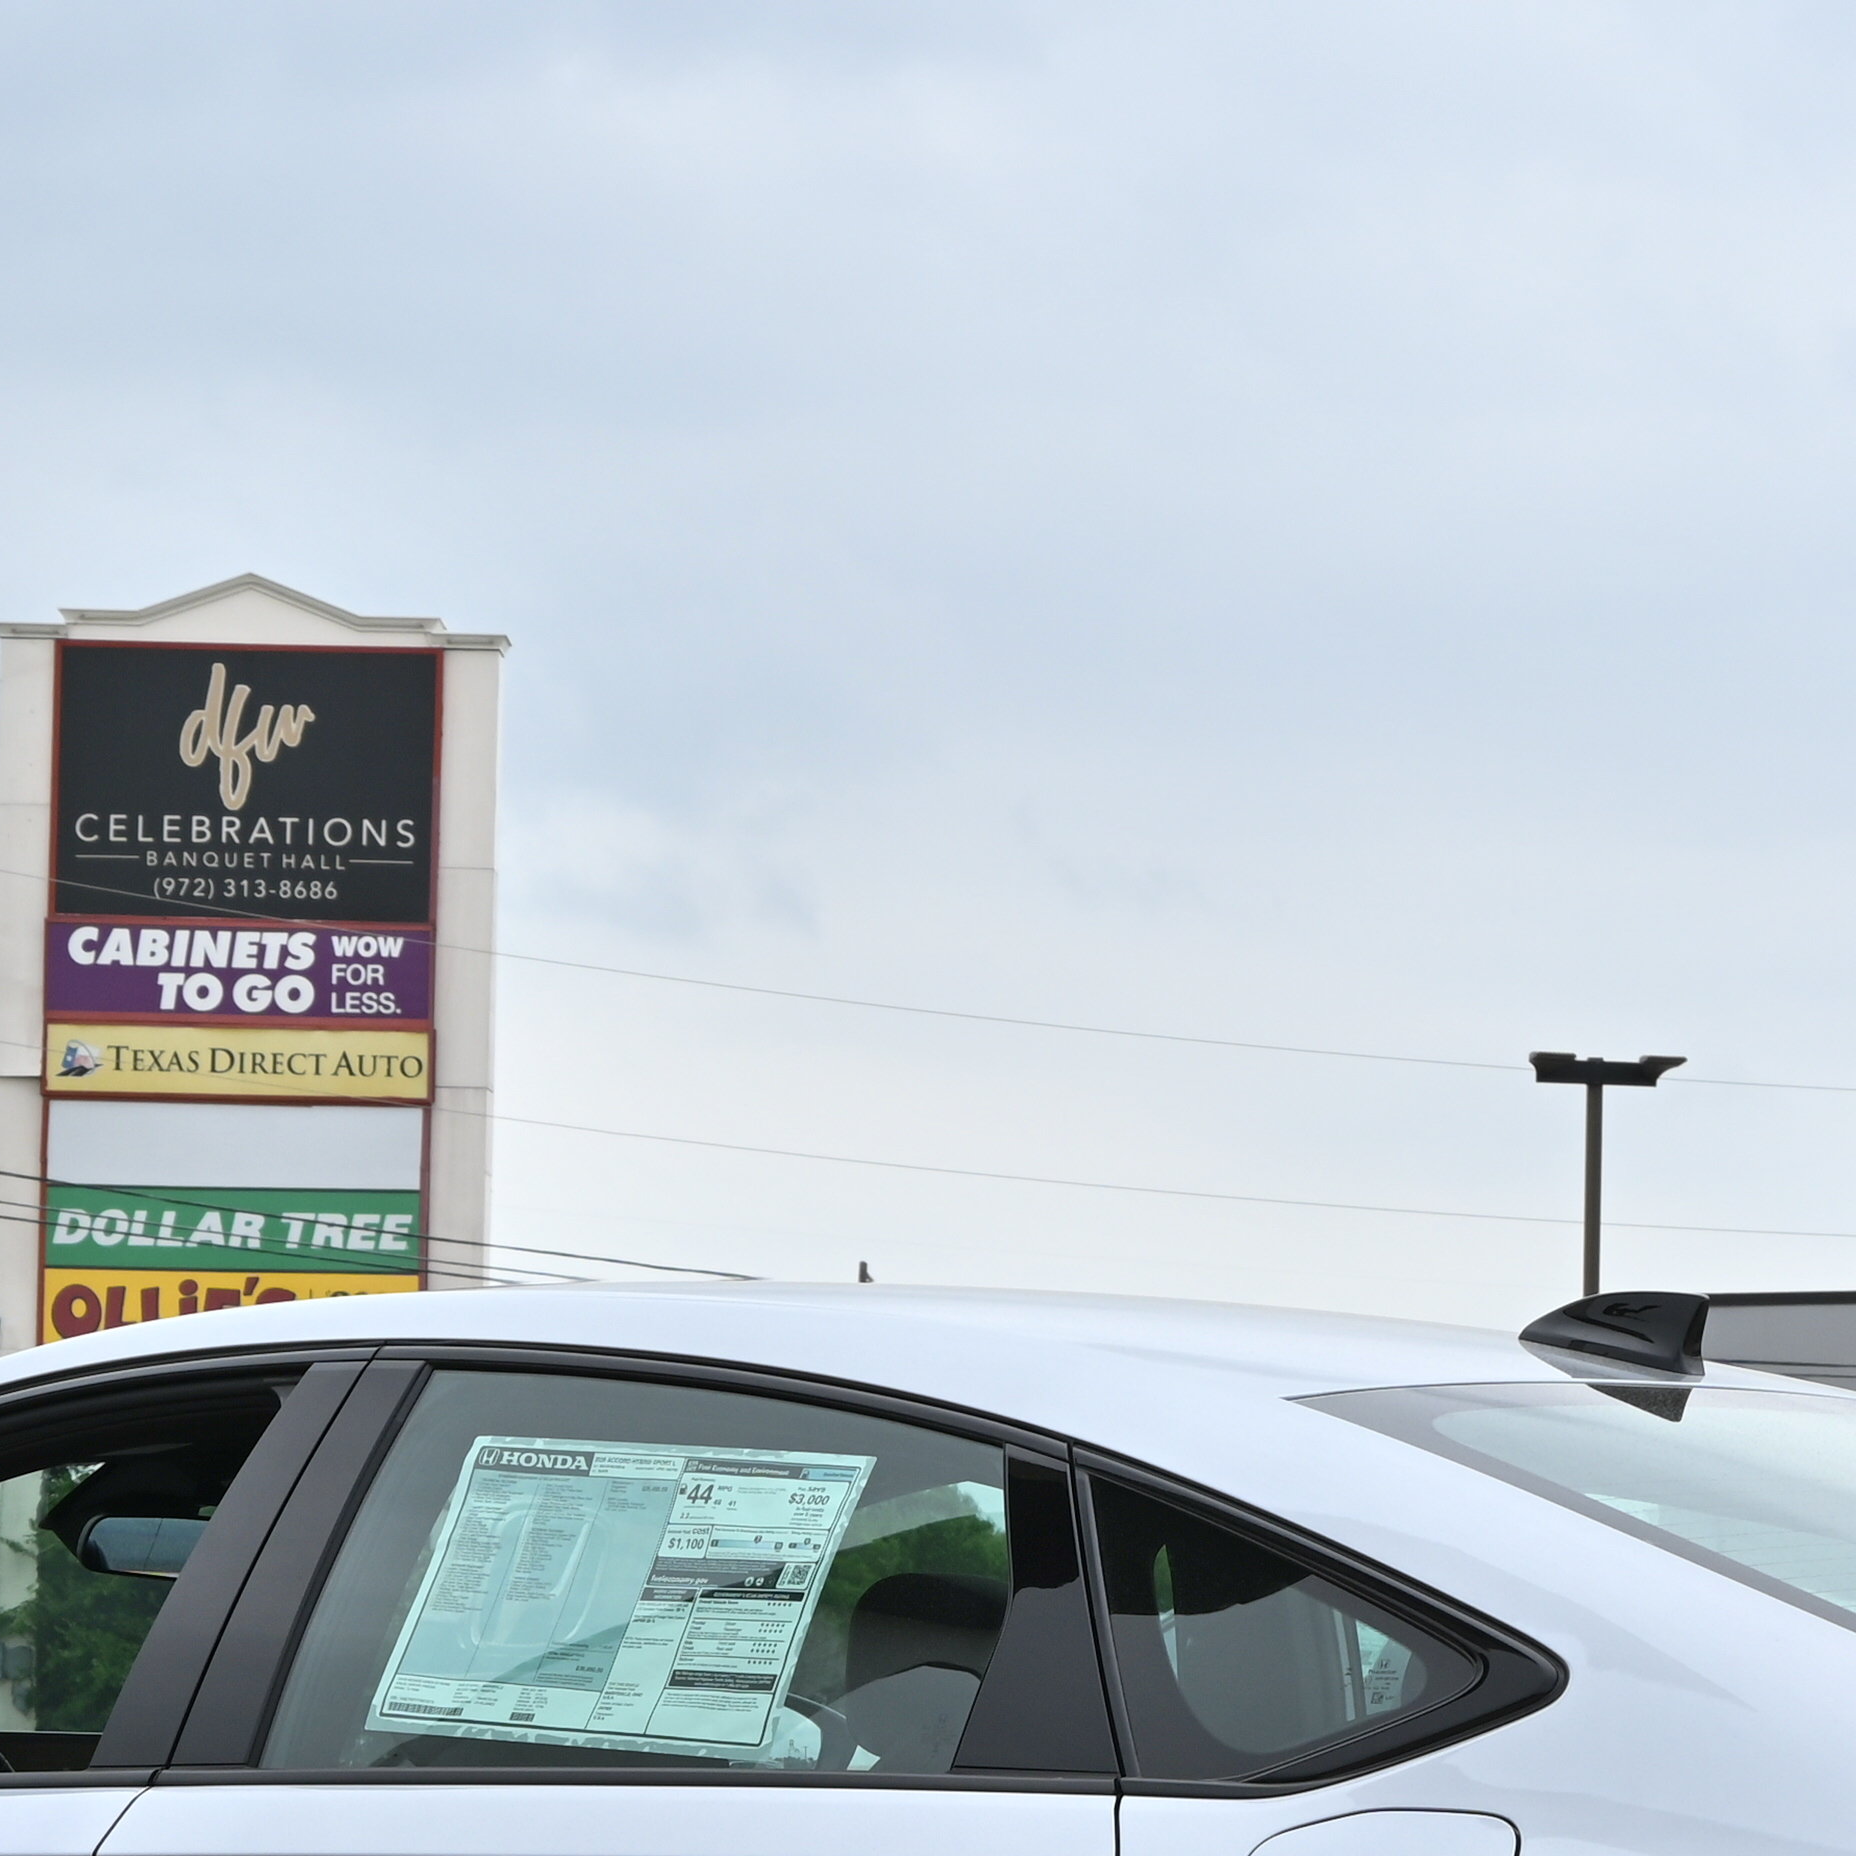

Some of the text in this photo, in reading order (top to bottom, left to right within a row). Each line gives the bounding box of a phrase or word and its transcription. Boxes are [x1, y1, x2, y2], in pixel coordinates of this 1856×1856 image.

[179, 662, 315, 811] dfw
[75, 813, 416, 848] CELEBRATIONS
[146, 850, 346, 871] BANQUET HALL
[153, 877, 338, 900] (972) 313-8686
[67, 926, 317, 971] CABINETS
[331, 935, 404, 958] WOW
[331, 963, 384, 986] FOR
[157, 971, 315, 1013] TO GO
[331, 991, 401, 1014] LESS.
[52, 1207, 413, 1252] DOLLAR TREE
[499, 1451, 590, 1470] HONDA
[712, 1464, 738, 1475] Economy
[751, 1467, 790, 1477] Environment
[687, 1484, 714, 1505] 44
[788, 1493, 831, 1506] $3,000
[668, 1538, 705, 1550] $1,100
